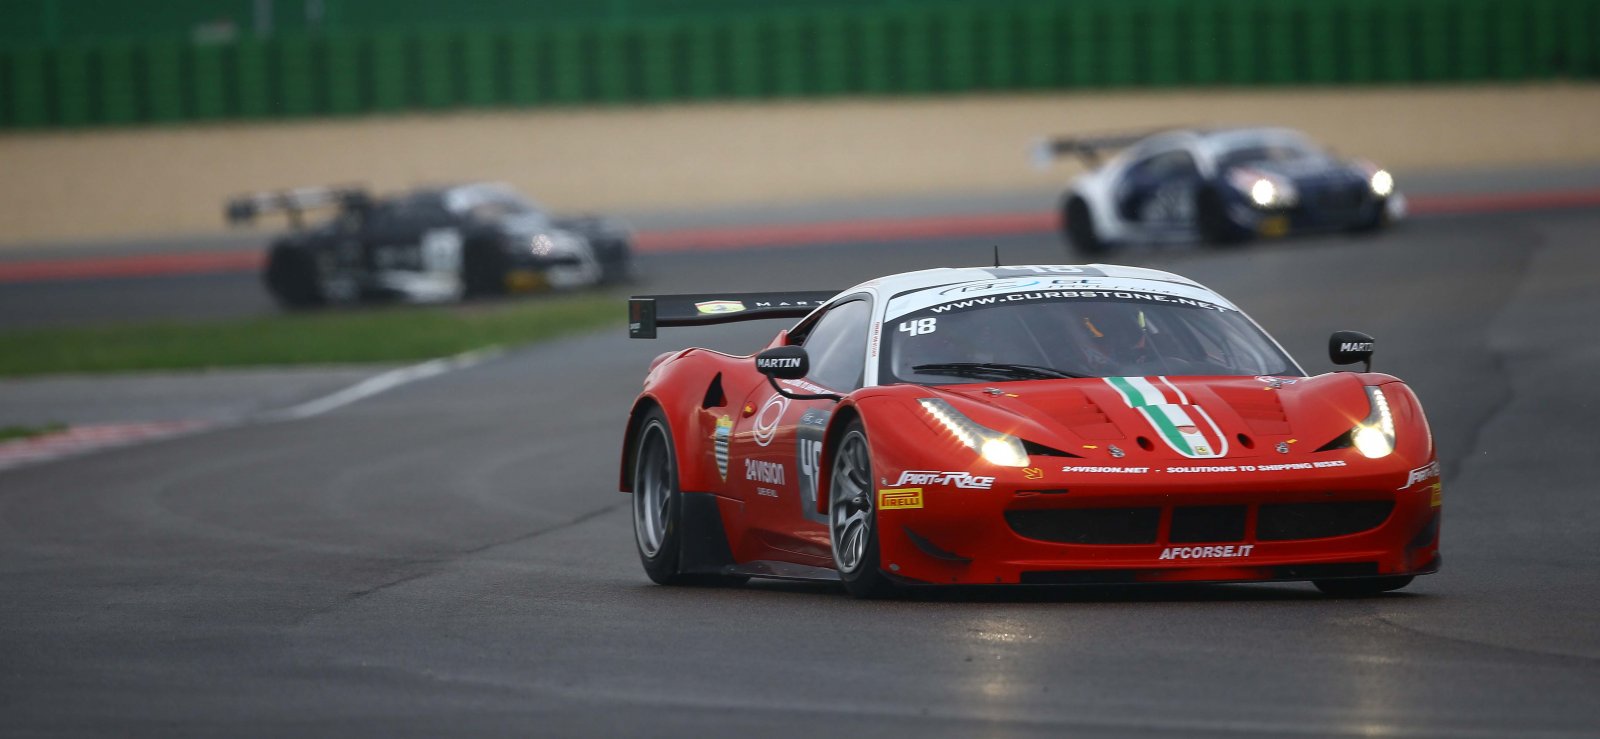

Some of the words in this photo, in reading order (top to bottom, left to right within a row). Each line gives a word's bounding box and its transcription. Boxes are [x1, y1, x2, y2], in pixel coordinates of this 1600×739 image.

[898, 317, 937, 336] 48
[757, 358, 801, 368] MARTIN
[744, 458, 786, 486] 24VISION
[1062, 466, 1149, 474] 24VISION.NET
[1166, 466, 1238, 474] SOLUTIONS
[1239, 465, 1256, 473] TO
[1257, 462, 1313, 472] SHIPPING
[942, 472, 996, 489] RACE
[881, 492, 920, 507] PIRELLI
[1159, 545, 1254, 560] AFCORSE.IT
